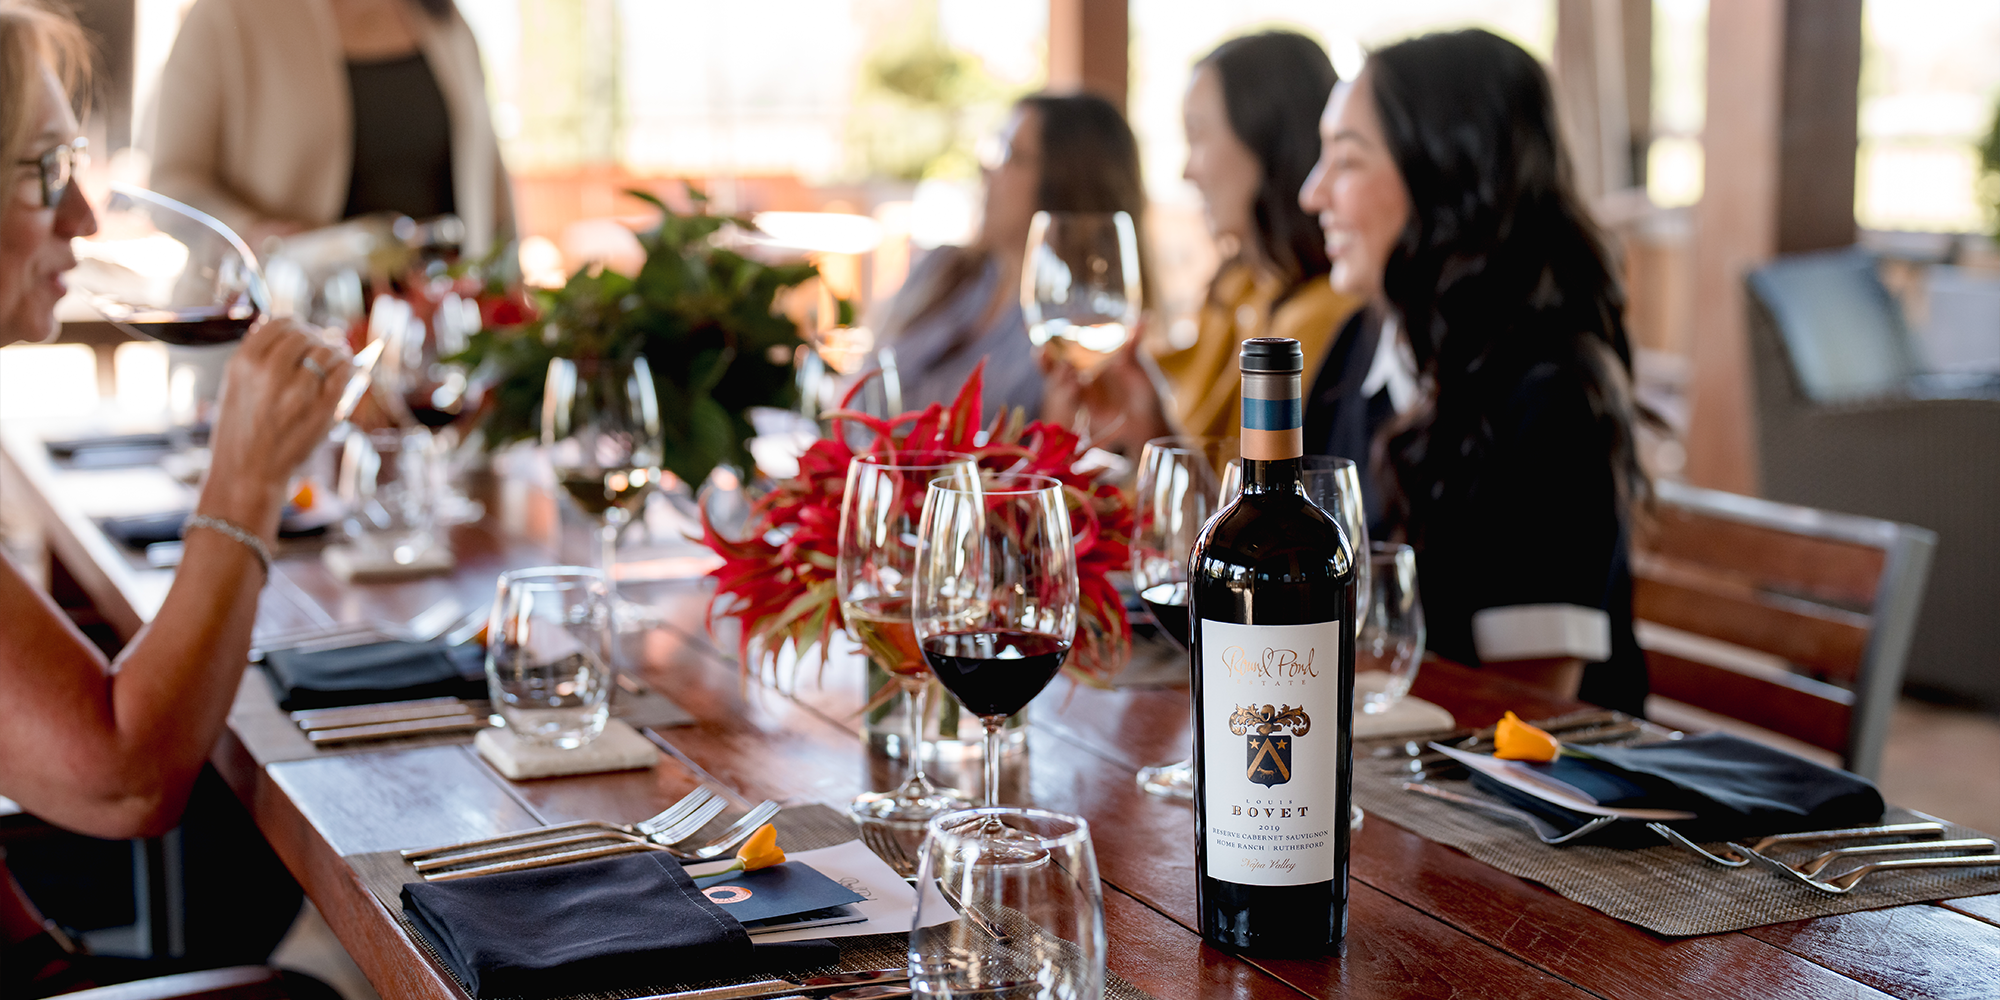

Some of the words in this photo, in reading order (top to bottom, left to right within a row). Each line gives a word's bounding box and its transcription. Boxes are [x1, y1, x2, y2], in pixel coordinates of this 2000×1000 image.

[1222, 645, 1273, 678] Round
[1267, 647, 1319, 677] Pond
[1231, 805, 1308, 818] BOVET
[1212, 827, 1240, 839] RESERVE
[1241, 832, 1283, 841] CABERNET
[1285, 829, 1329, 841] SAUVIGNON
[1216, 838, 1235, 848] HOME
[1237, 842, 1265, 851] RANCH
[1273, 841, 1324, 851] RUTHERFORD
[1240, 857, 1266, 872] Napa
[1268, 858, 1297, 873] Valley
